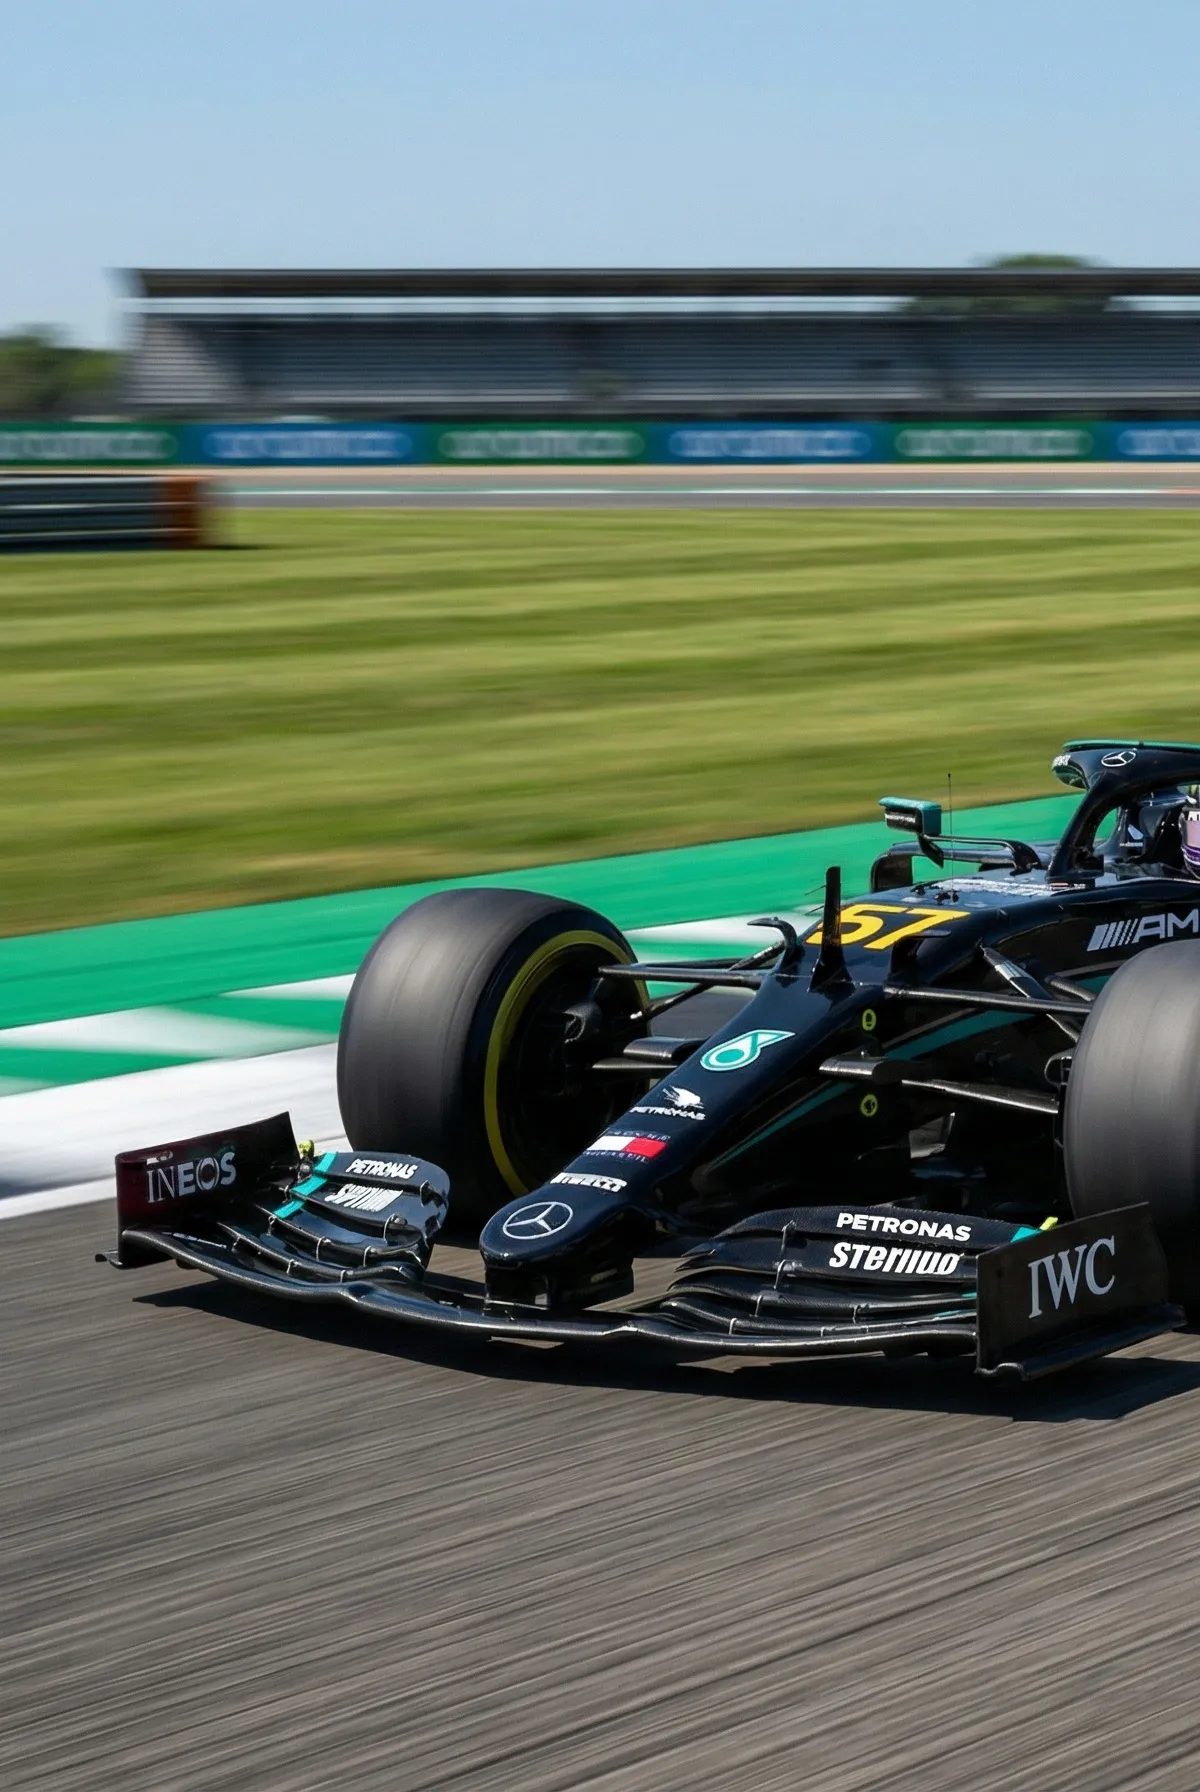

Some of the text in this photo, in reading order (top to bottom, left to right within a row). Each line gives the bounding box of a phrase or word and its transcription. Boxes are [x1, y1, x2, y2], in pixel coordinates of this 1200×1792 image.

[805, 903, 971, 949] 57
[146, 1152, 237, 1203] INEOS
[836, 1212, 972, 1242] PETRONAS
[1028, 1235, 1115, 1319] IWC
